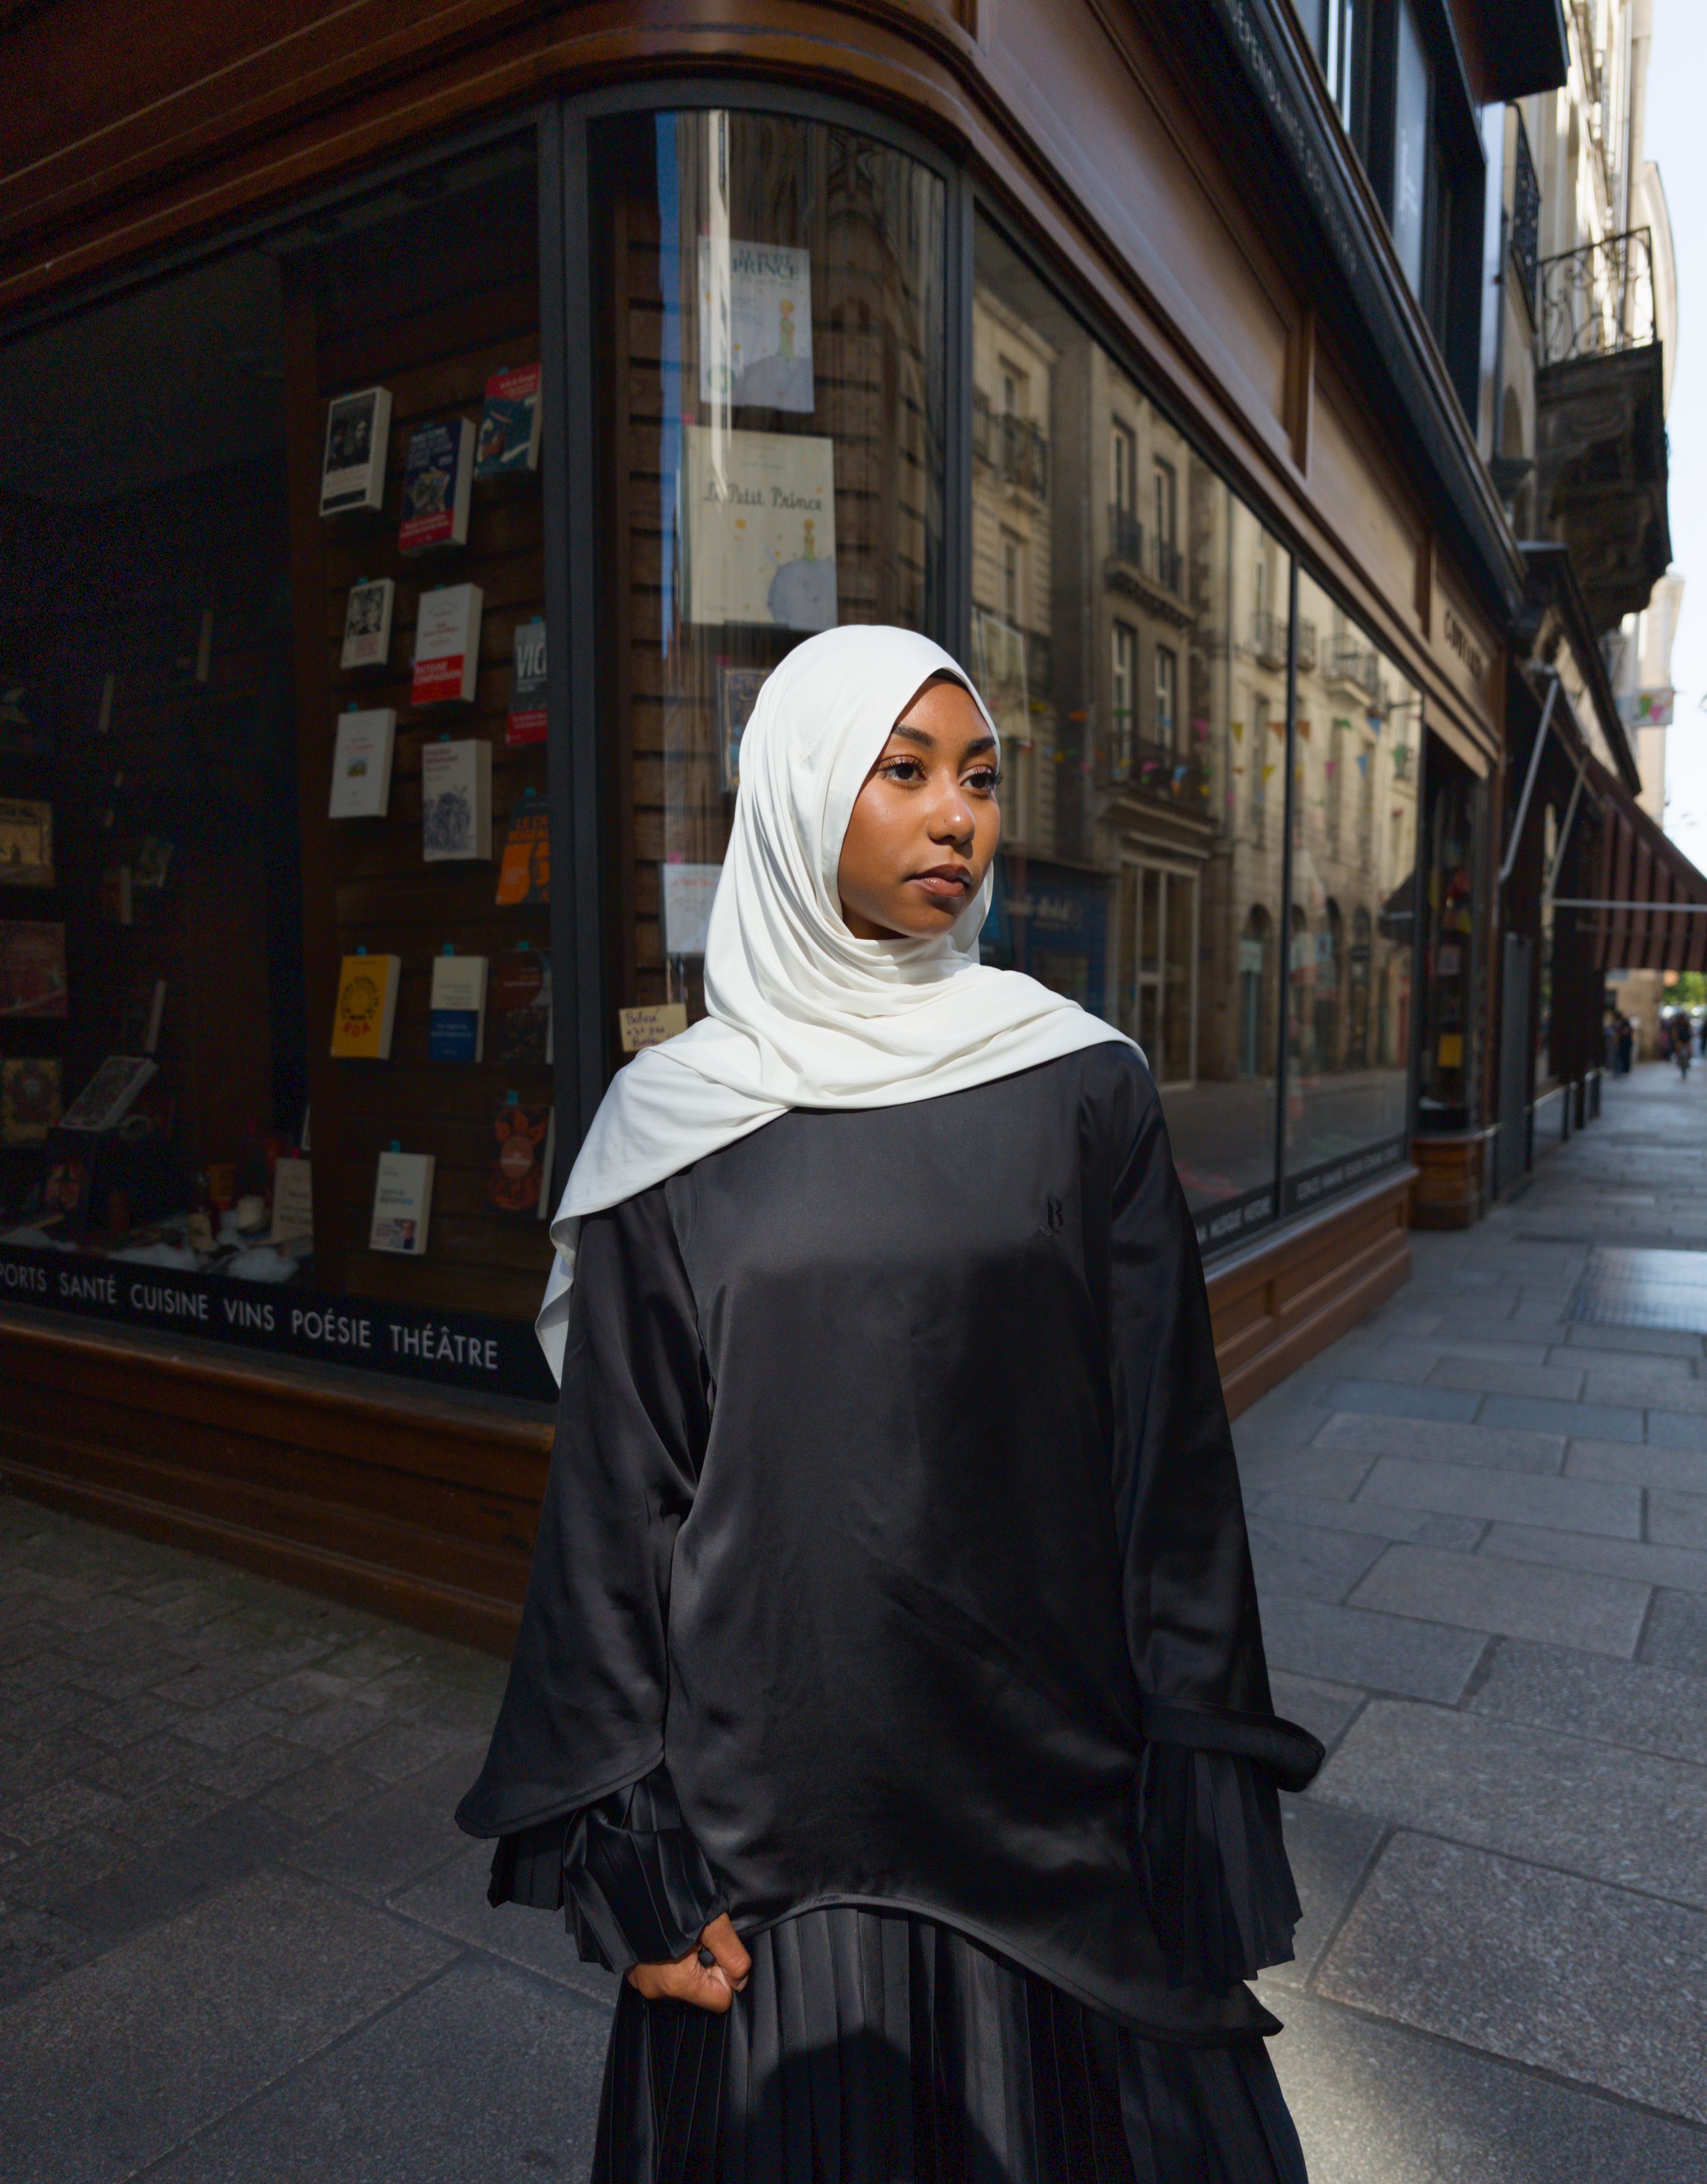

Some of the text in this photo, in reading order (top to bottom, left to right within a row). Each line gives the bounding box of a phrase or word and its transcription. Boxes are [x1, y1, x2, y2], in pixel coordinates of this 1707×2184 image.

[727, 482, 764, 506] Petit
[770, 485, 822, 511] Prince
[58, 1272, 117, 1305] SANTÉ
[130, 1283, 210, 1321] CUISINE
[223, 1297, 276, 1332] VINS
[290, 1307, 372, 1349] POÉSIE
[389, 1322, 499, 1371] THÉÂTRE
